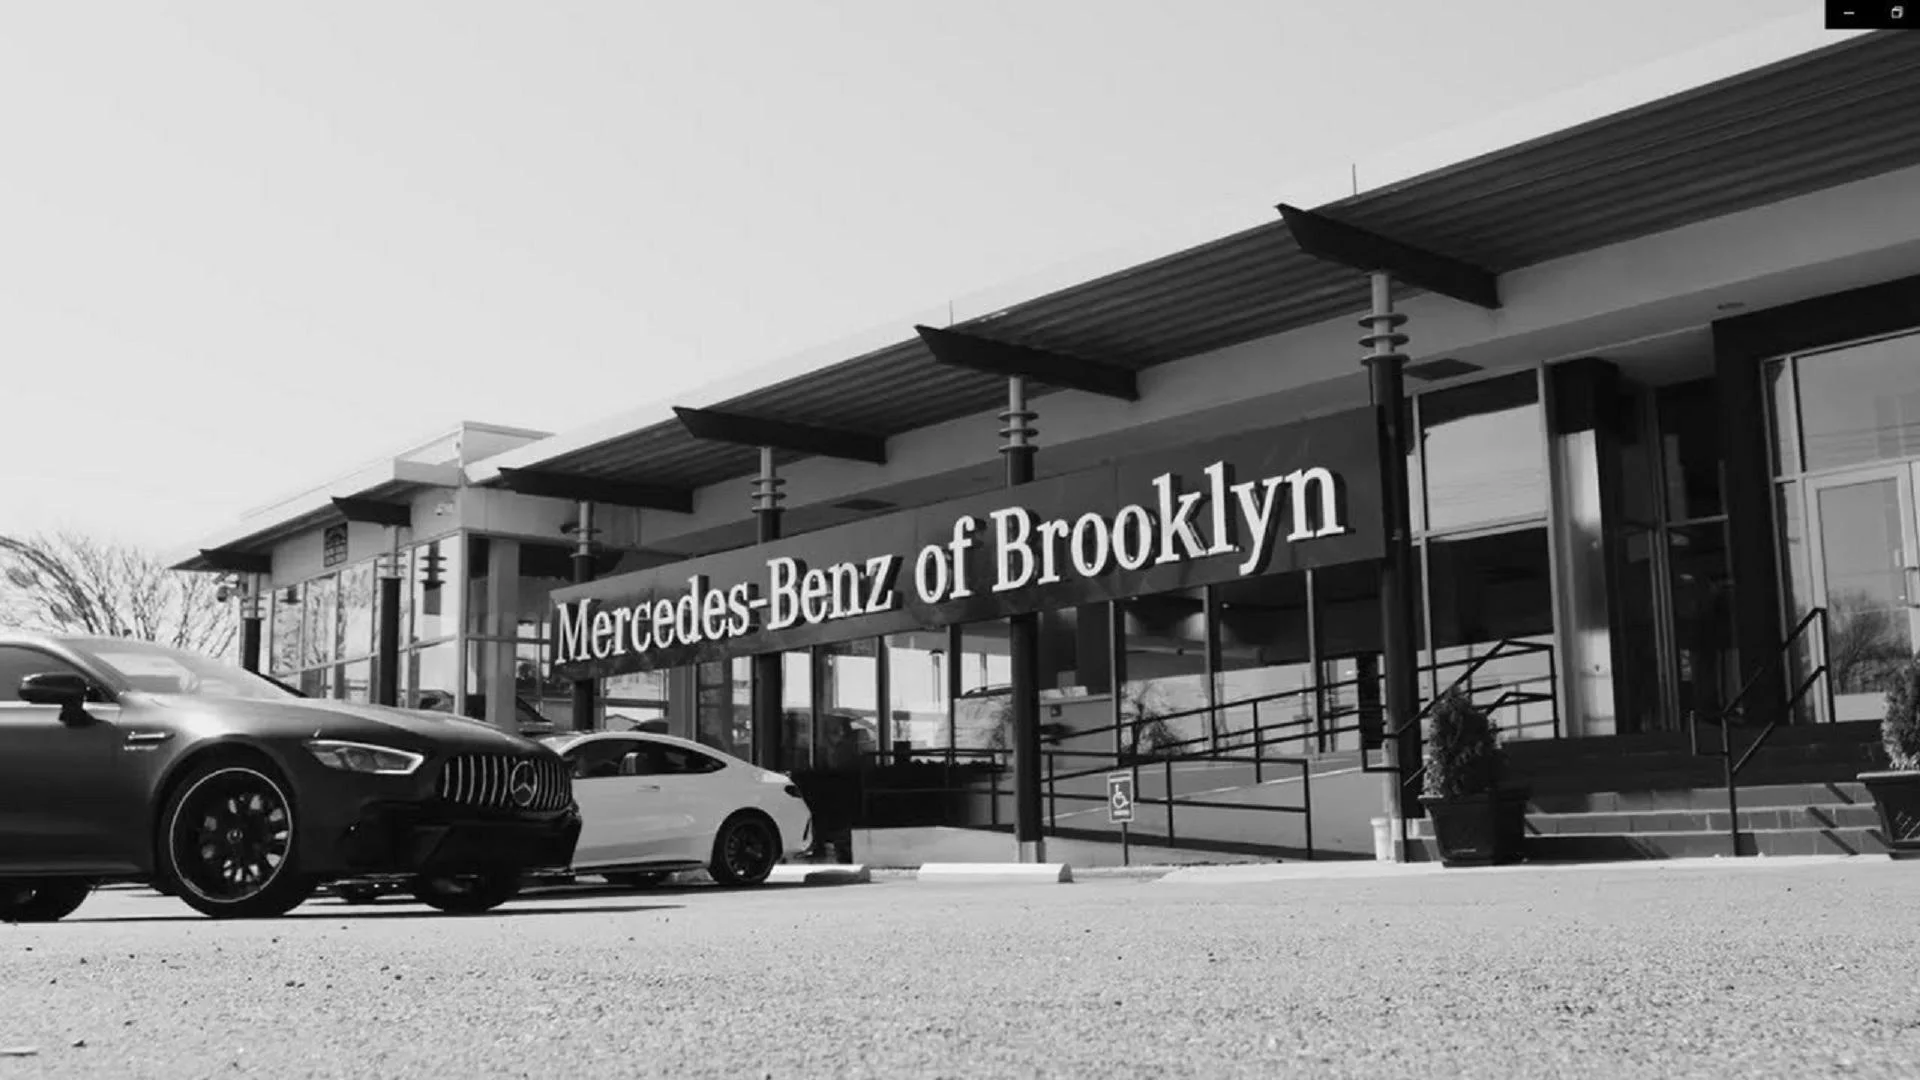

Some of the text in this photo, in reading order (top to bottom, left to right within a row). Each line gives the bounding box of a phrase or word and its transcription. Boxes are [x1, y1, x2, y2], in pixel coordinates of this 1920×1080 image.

[555, 461, 1345, 665] Mercedes-Benz of Brooklyn
